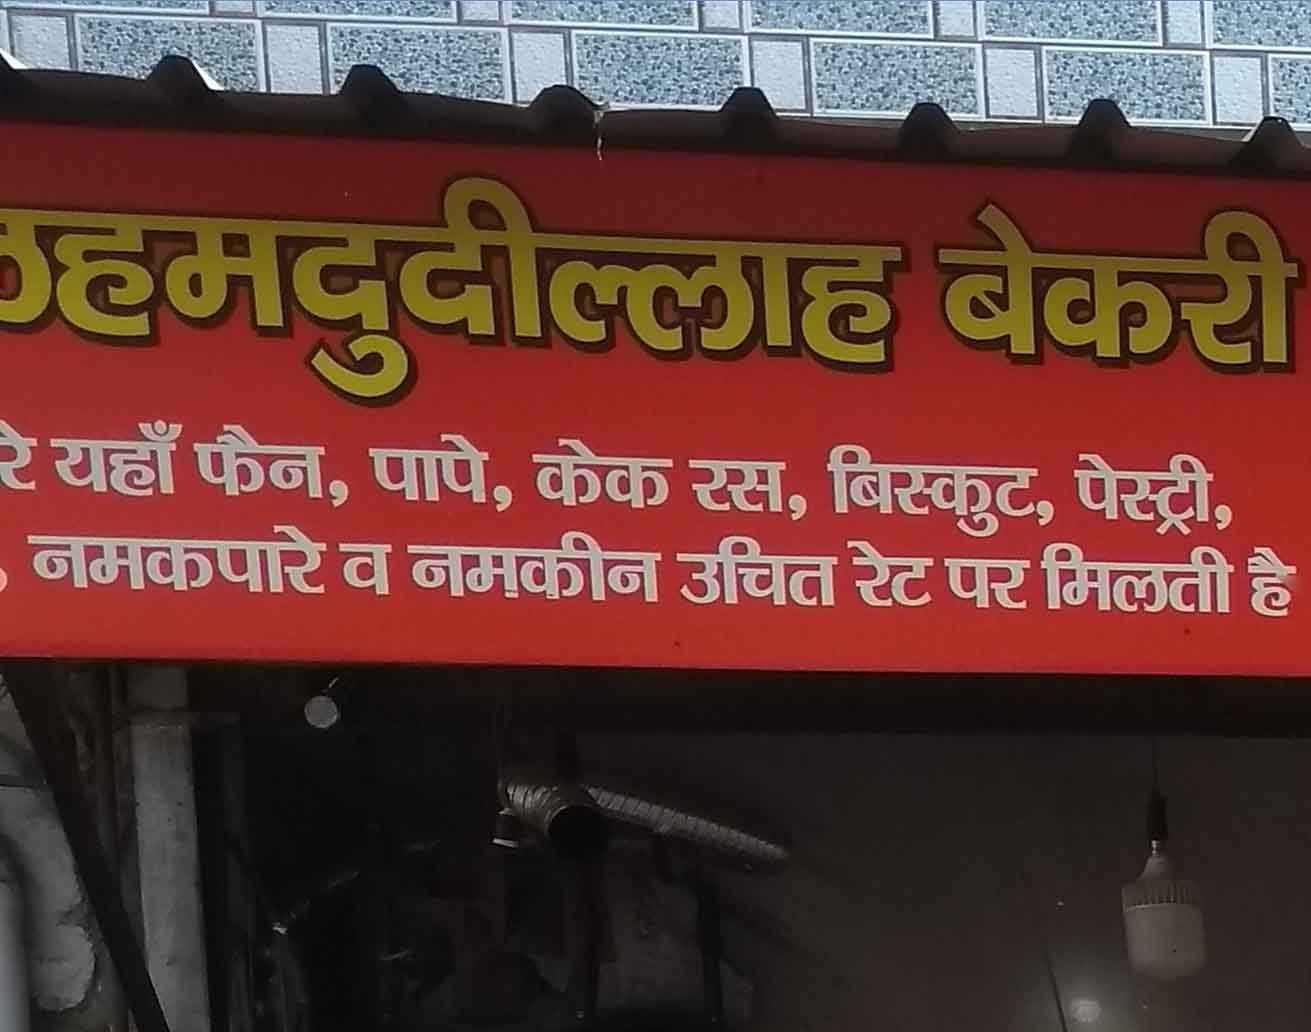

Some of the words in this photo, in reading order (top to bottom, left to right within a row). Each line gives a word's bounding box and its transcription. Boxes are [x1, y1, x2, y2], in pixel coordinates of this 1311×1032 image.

[938, 203, 1298, 366] बेकरी
[50, 419, 182, 497] यहाँ
[193, 424, 349, 507] फैन,
[368, 433, 513, 513] पापे,
[532, 438, 673, 508] केक
[688, 459, 807, 521] रस,
[827, 444, 1054, 537] बिस्कुट,
[1073, 453, 1232, 535] पेस्ट्री,
[27, 524, 327, 594] नमकपारे
[338, 542, 392, 595] व
[407, 530, 662, 602] नमकीन
[676, 535, 838, 606] उचित
[847, 540, 934, 607] रेट
[944, 557, 1031, 609] पर
[1040, 542, 1234, 613] मिलती
[1248, 546, 1296, 617] है
